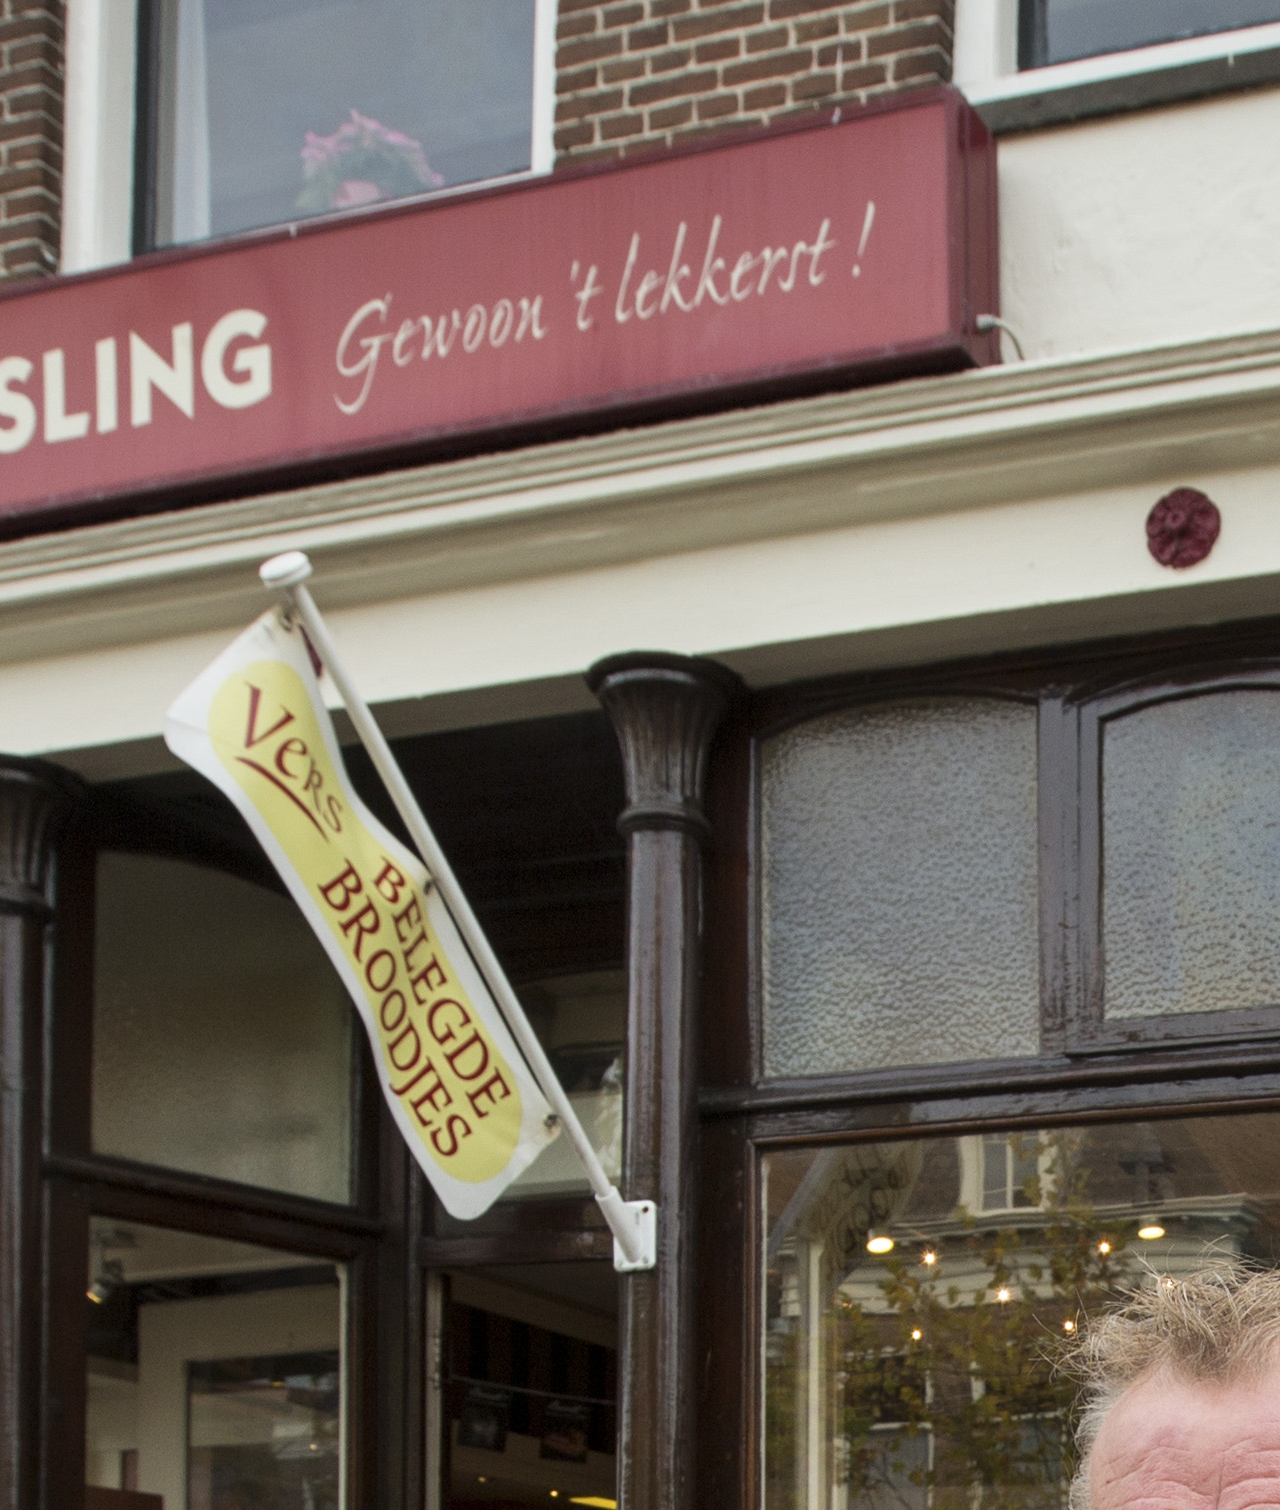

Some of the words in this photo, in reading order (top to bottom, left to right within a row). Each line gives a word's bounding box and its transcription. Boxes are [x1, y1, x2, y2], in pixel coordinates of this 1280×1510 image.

[333, 292, 548, 415] Gewoon
[569, 260, 603, 331] 't
[614, 214, 836, 323] lekkerst
[317, 859, 473, 1158] BROODJES
[371, 856, 512, 1118] BELEGDE
